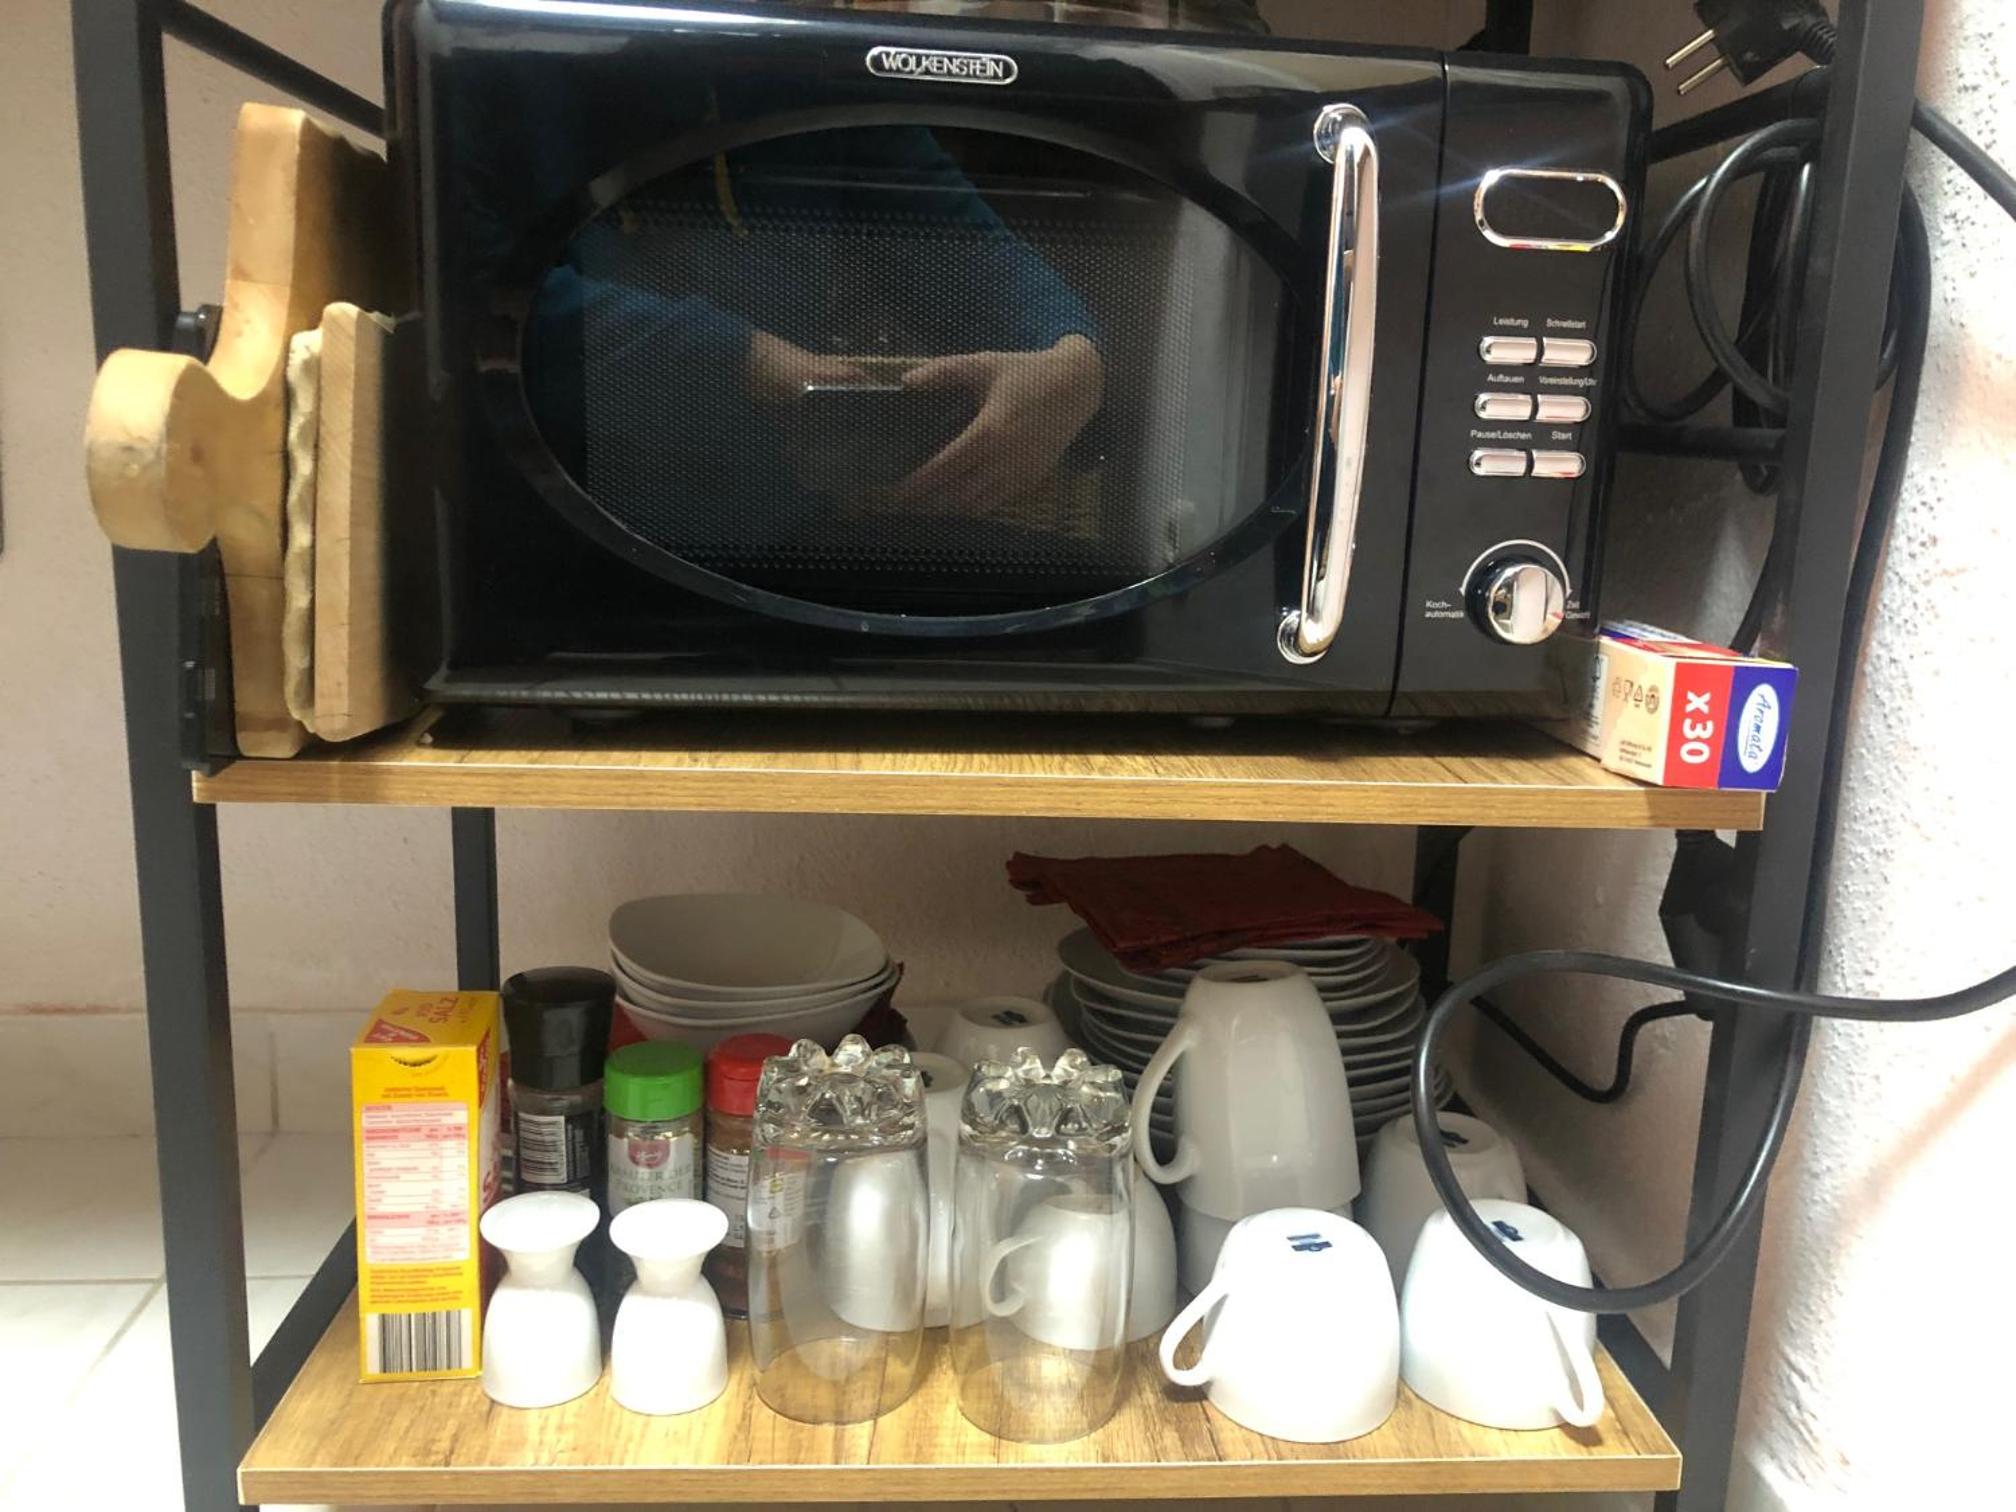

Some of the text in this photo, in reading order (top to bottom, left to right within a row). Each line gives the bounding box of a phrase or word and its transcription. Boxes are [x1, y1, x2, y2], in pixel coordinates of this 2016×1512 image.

[881, 51, 1004, 78] WOLKENSTEIN
[1493, 316, 1529, 328] Leistung
[1546, 318, 1587, 329] Schnellstart
[1487, 373, 1525, 383] Auftauen
[1470, 429, 1532, 440] Pause/Löschen
[1551, 430, 1573, 440] Start
[1425, 600, 1452, 609] Koch-
[1424, 610, 1465, 619] automatik
[1746, 692, 1772, 760] Aromata
